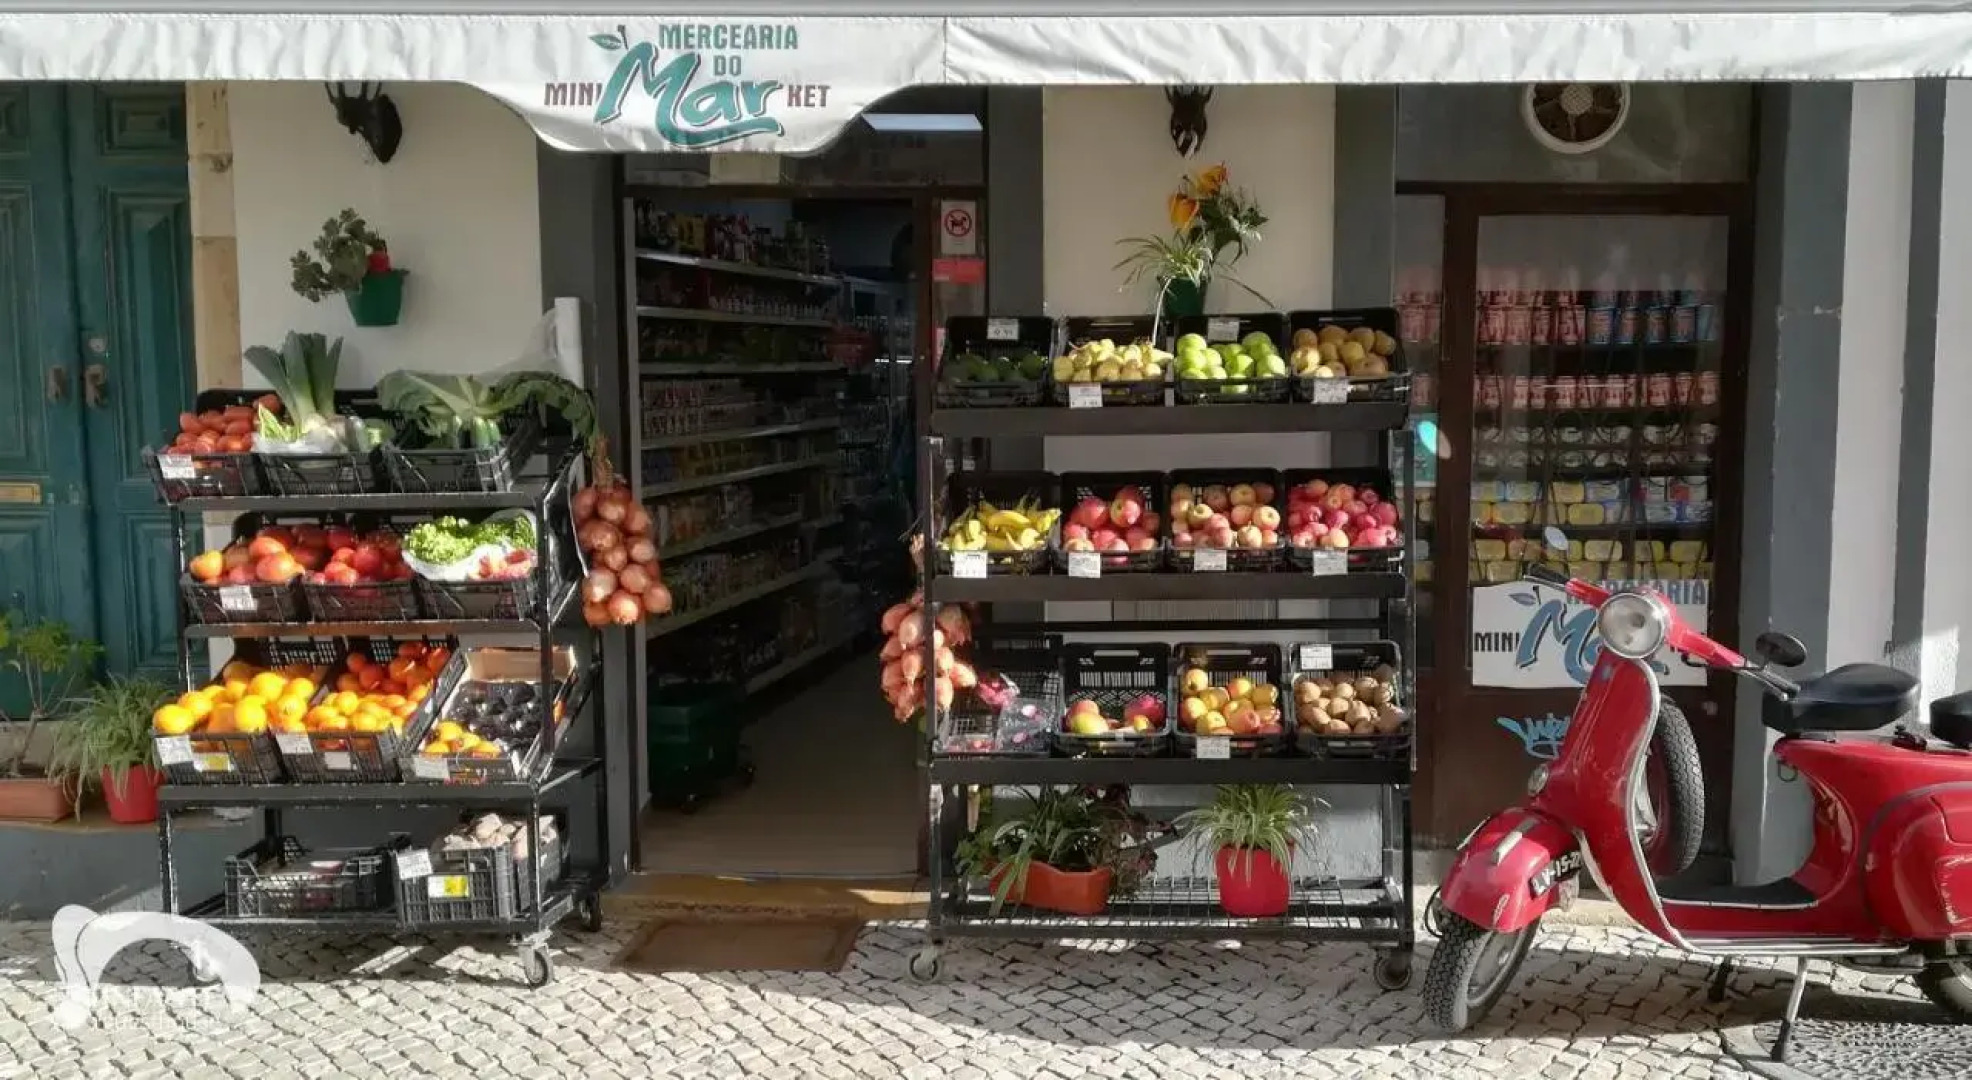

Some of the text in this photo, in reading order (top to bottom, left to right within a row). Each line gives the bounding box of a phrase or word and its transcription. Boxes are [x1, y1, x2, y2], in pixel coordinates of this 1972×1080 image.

[658, 24, 799, 50] MERCEARIA
[713, 55, 742, 77] DO
[544, 82, 603, 106] MINI
